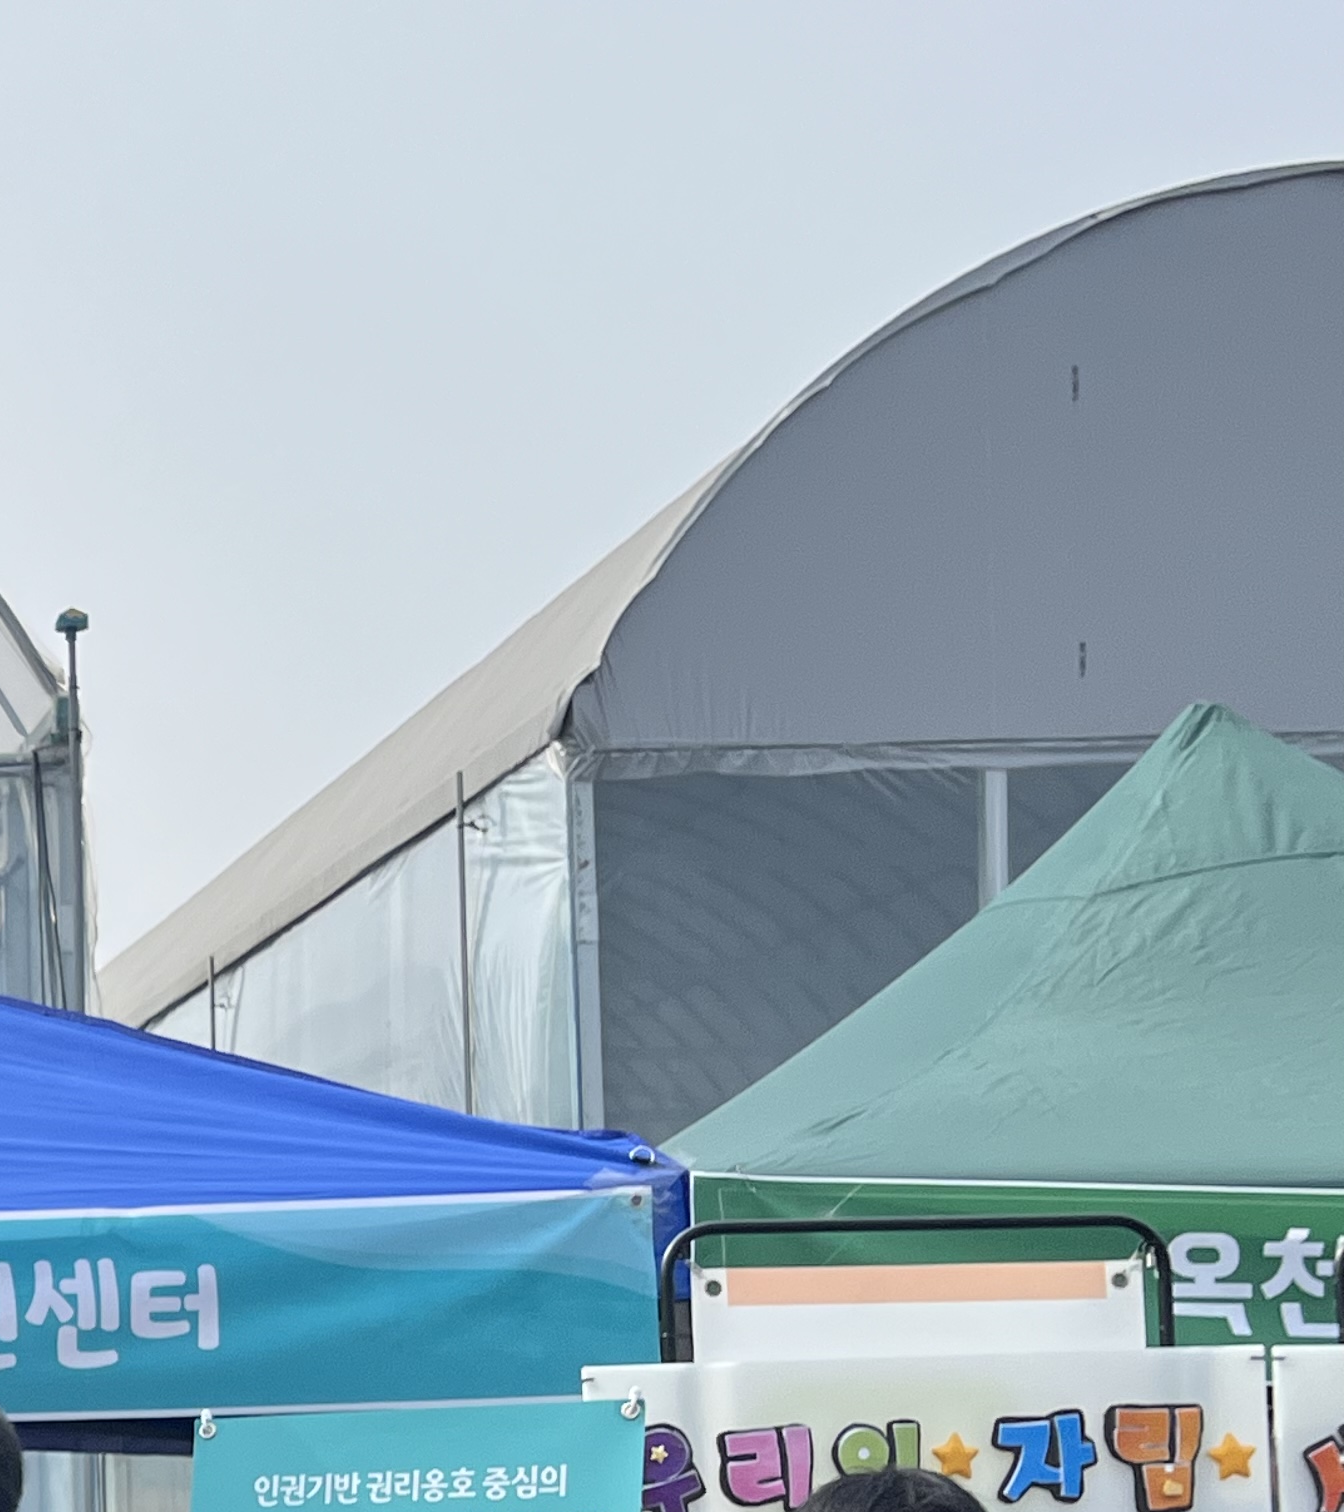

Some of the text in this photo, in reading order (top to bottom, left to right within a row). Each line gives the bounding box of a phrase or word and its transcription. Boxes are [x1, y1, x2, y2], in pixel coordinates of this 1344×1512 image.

[254, 1463, 568, 1507] 인권기반 권리옹호 중심의
